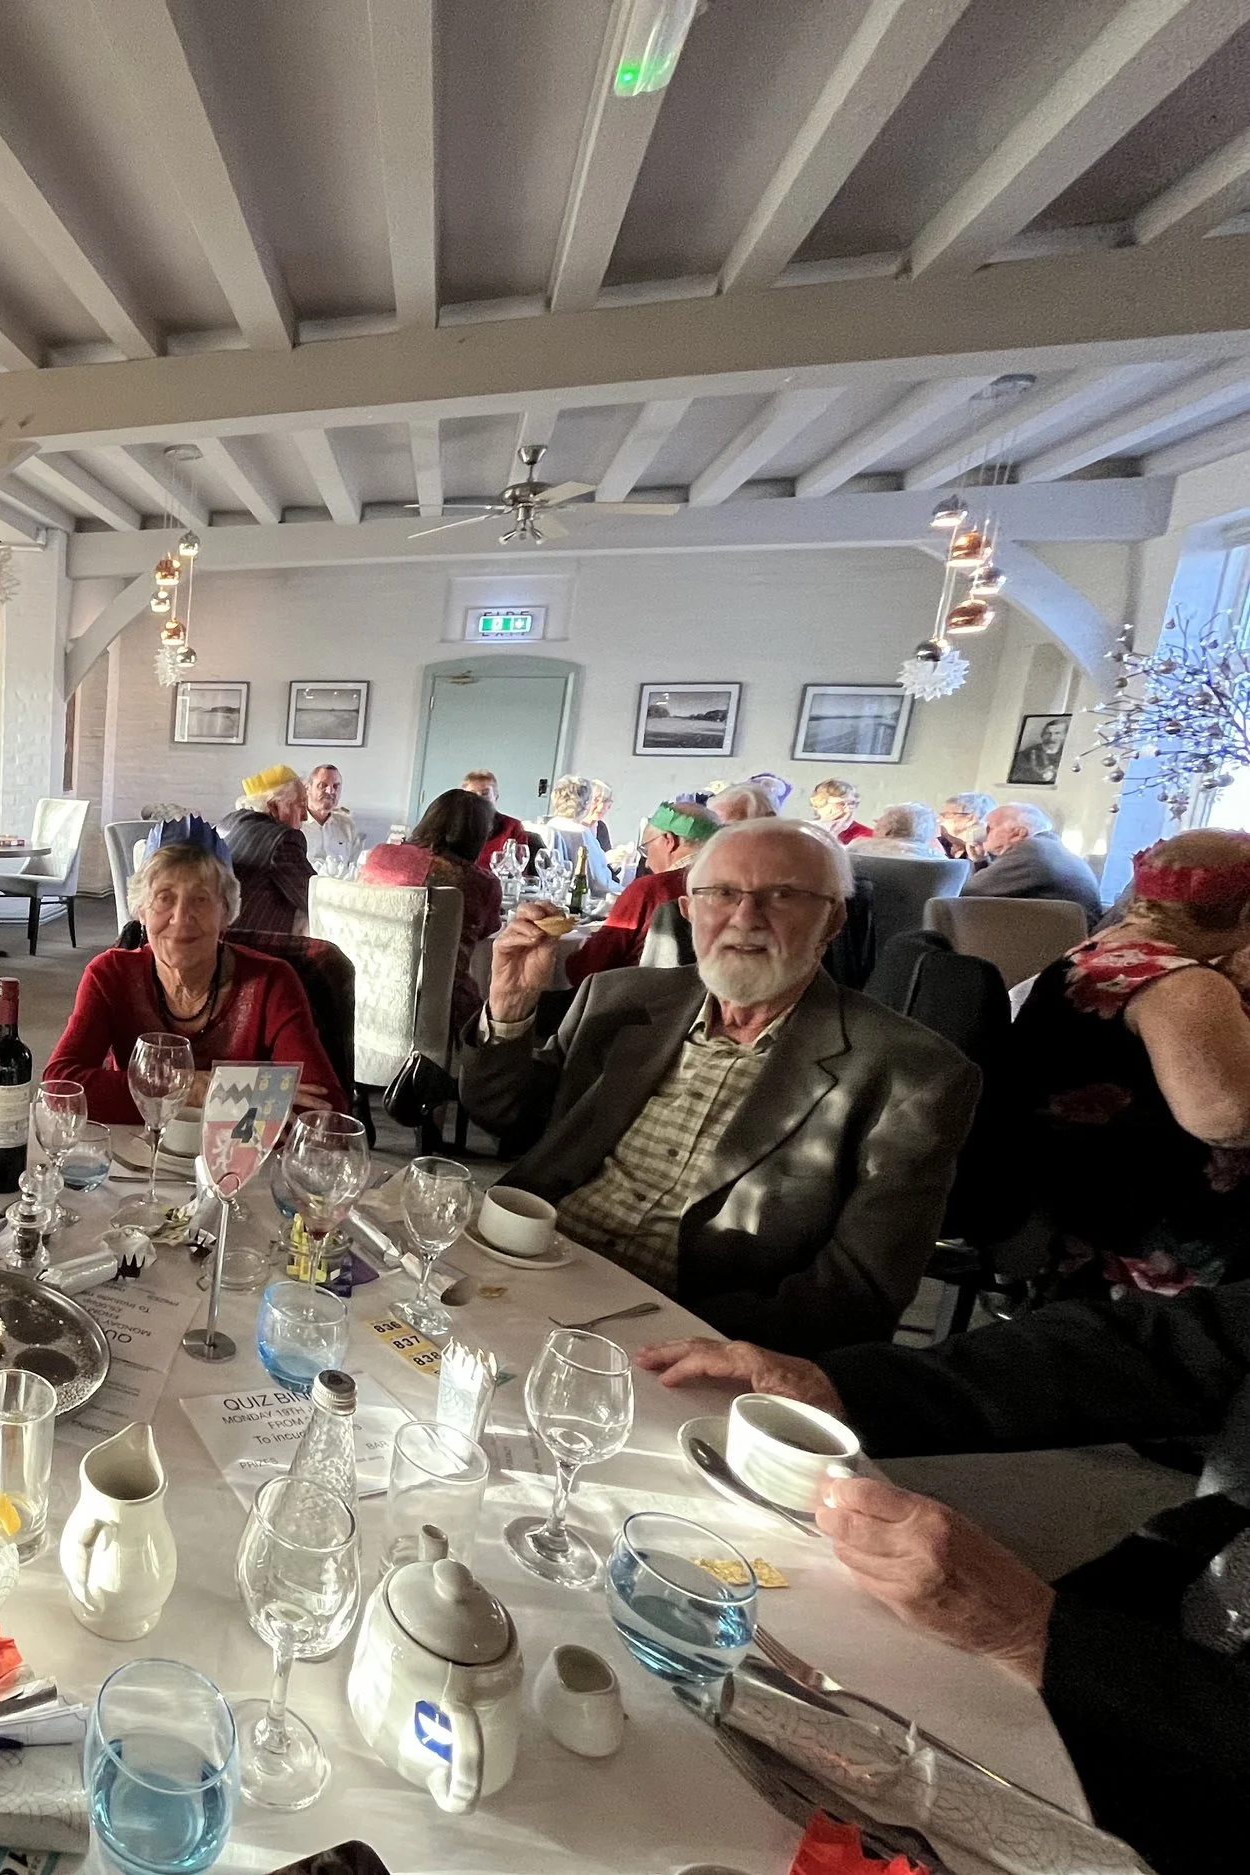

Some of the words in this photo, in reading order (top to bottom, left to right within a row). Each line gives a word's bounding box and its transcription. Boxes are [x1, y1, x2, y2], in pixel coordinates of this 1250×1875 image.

[231, 1107, 258, 1143] 4
[374, 1321, 402, 1333] 836
[393, 1335, 420, 1349] 837
[413, 1351, 442, 1366] 838
[223, 1394, 274, 1412] QUIZ
[274, 1391, 313, 1405] BIN
[222, 1410, 272, 1425] MONDAY
[276, 1406, 304, 1418] 19TH
[268, 1417, 304, 1430] FROM
[253, 1434, 271, 1446] To
